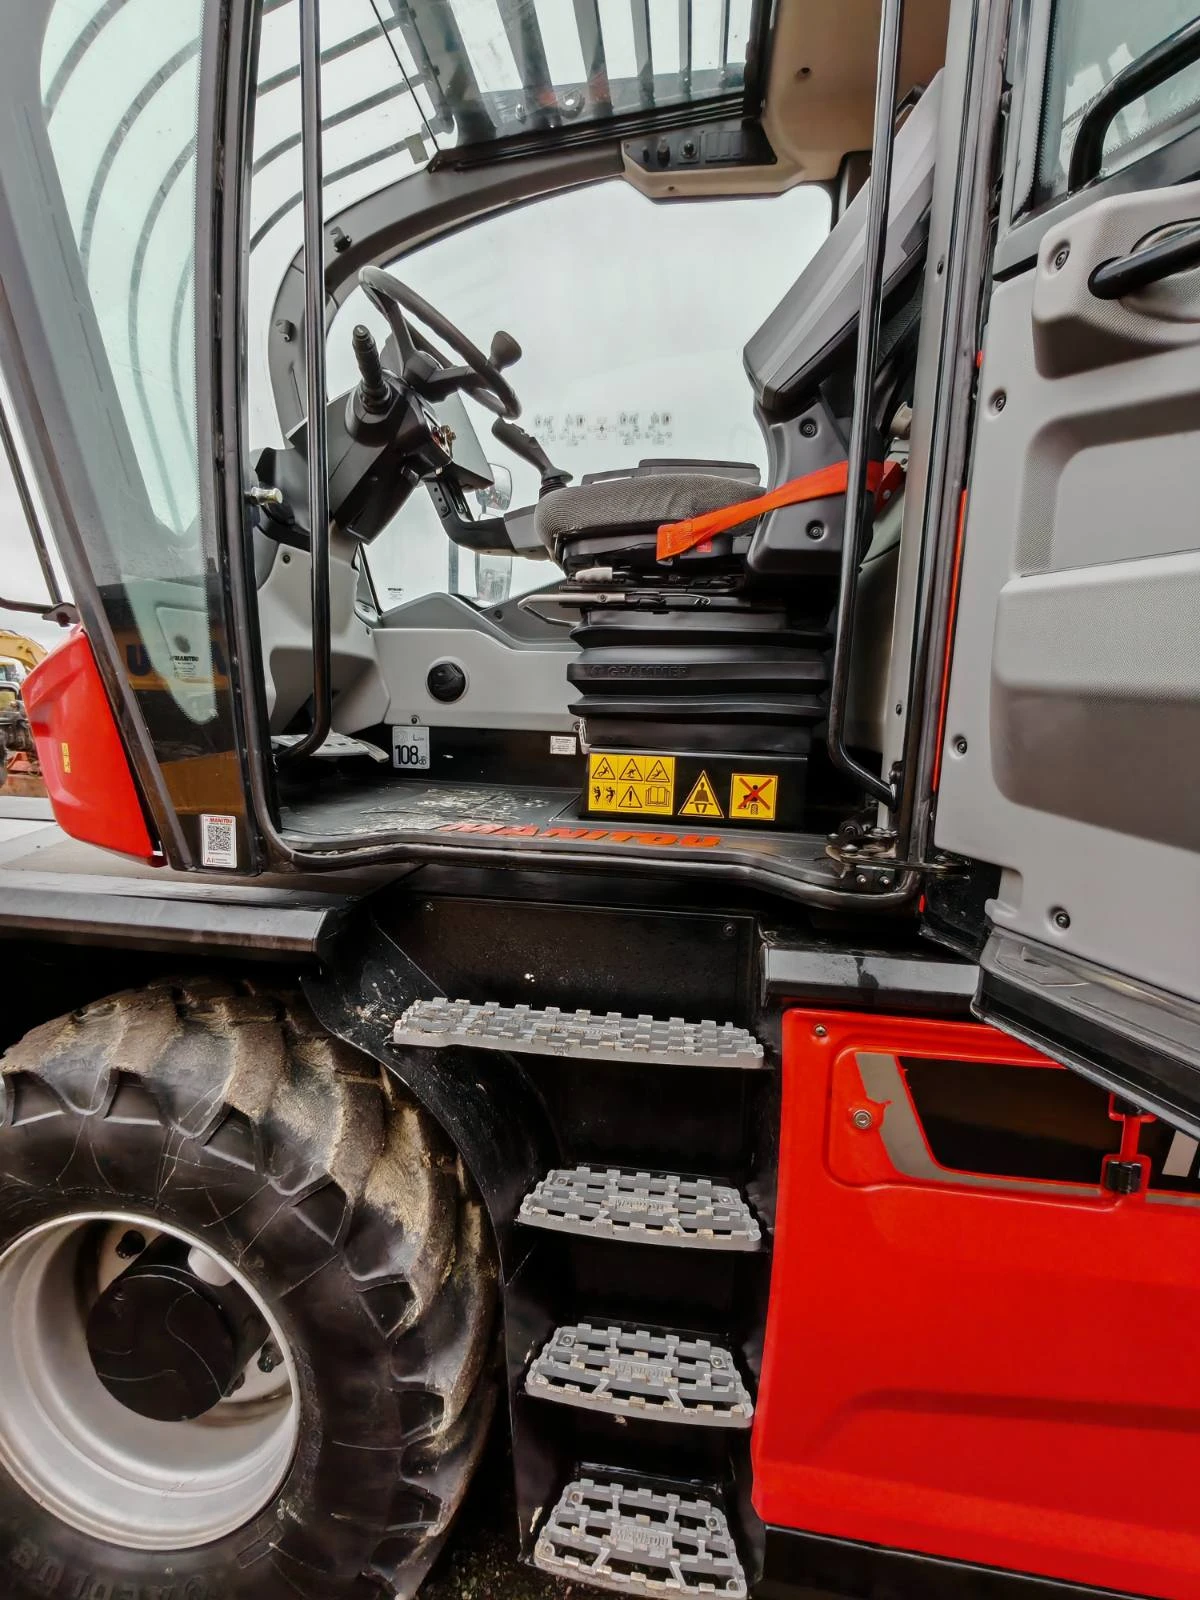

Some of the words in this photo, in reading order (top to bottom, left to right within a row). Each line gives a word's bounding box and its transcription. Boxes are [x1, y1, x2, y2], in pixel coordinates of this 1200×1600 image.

[607, 664, 690, 679] GRAMMER
[395, 744, 419, 765] 108
[436, 823, 722, 848] MANITOU
